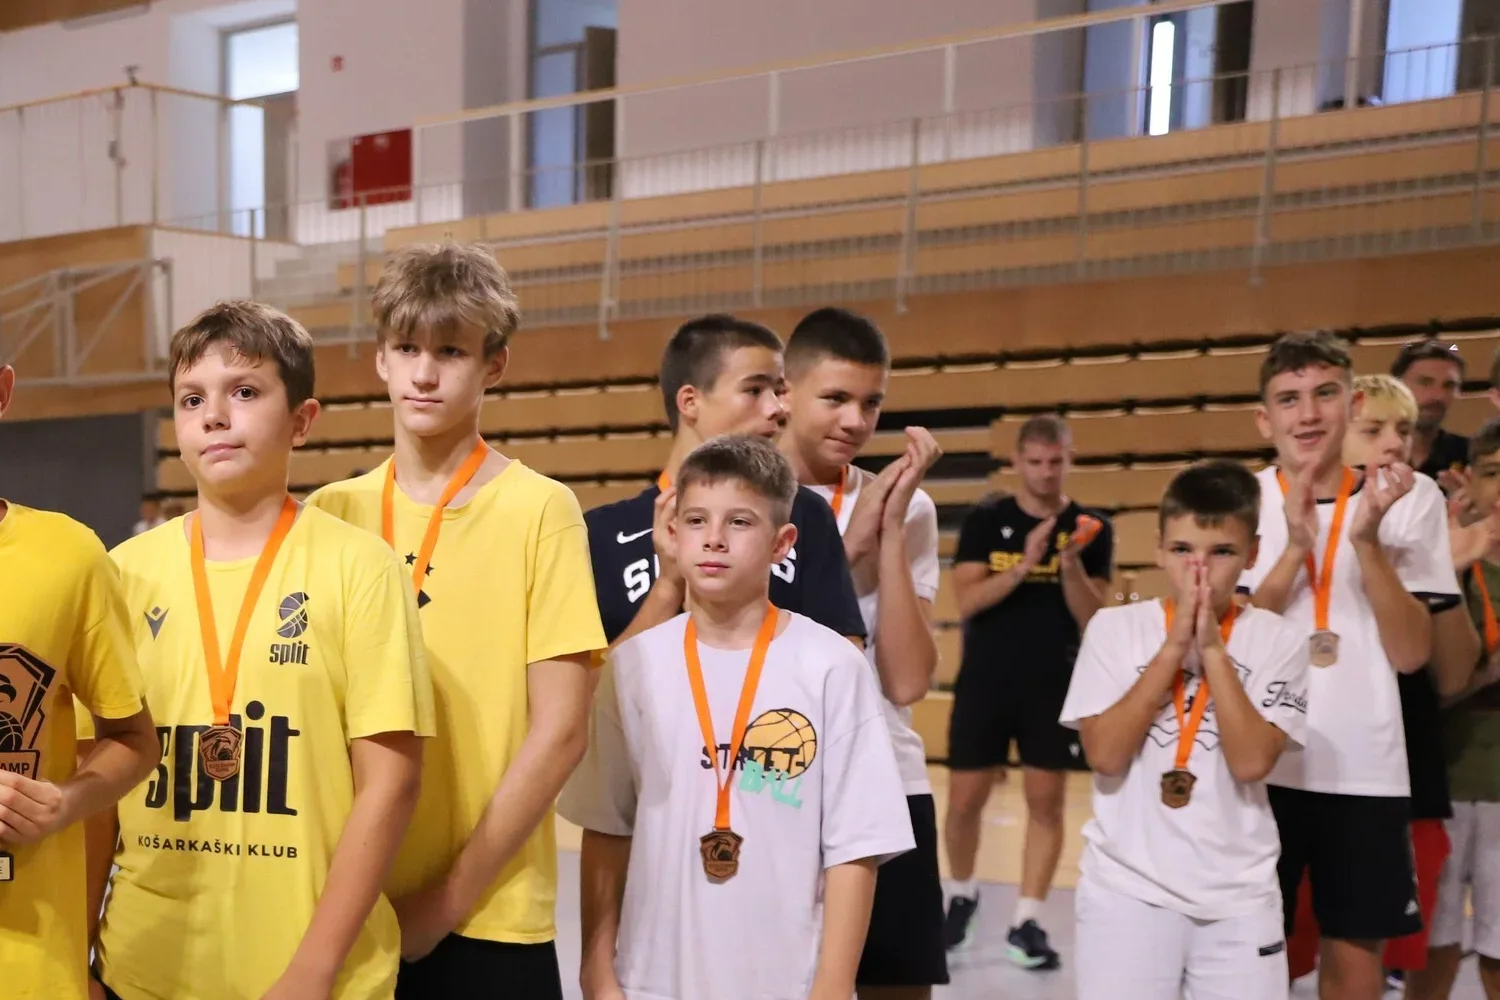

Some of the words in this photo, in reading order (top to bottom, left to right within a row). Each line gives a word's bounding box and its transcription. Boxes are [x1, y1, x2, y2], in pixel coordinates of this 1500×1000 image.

[269, 641, 310, 665] split
[138, 835, 241, 856] KOŠARKAŠKI
[248, 844, 298, 859] KLUB
